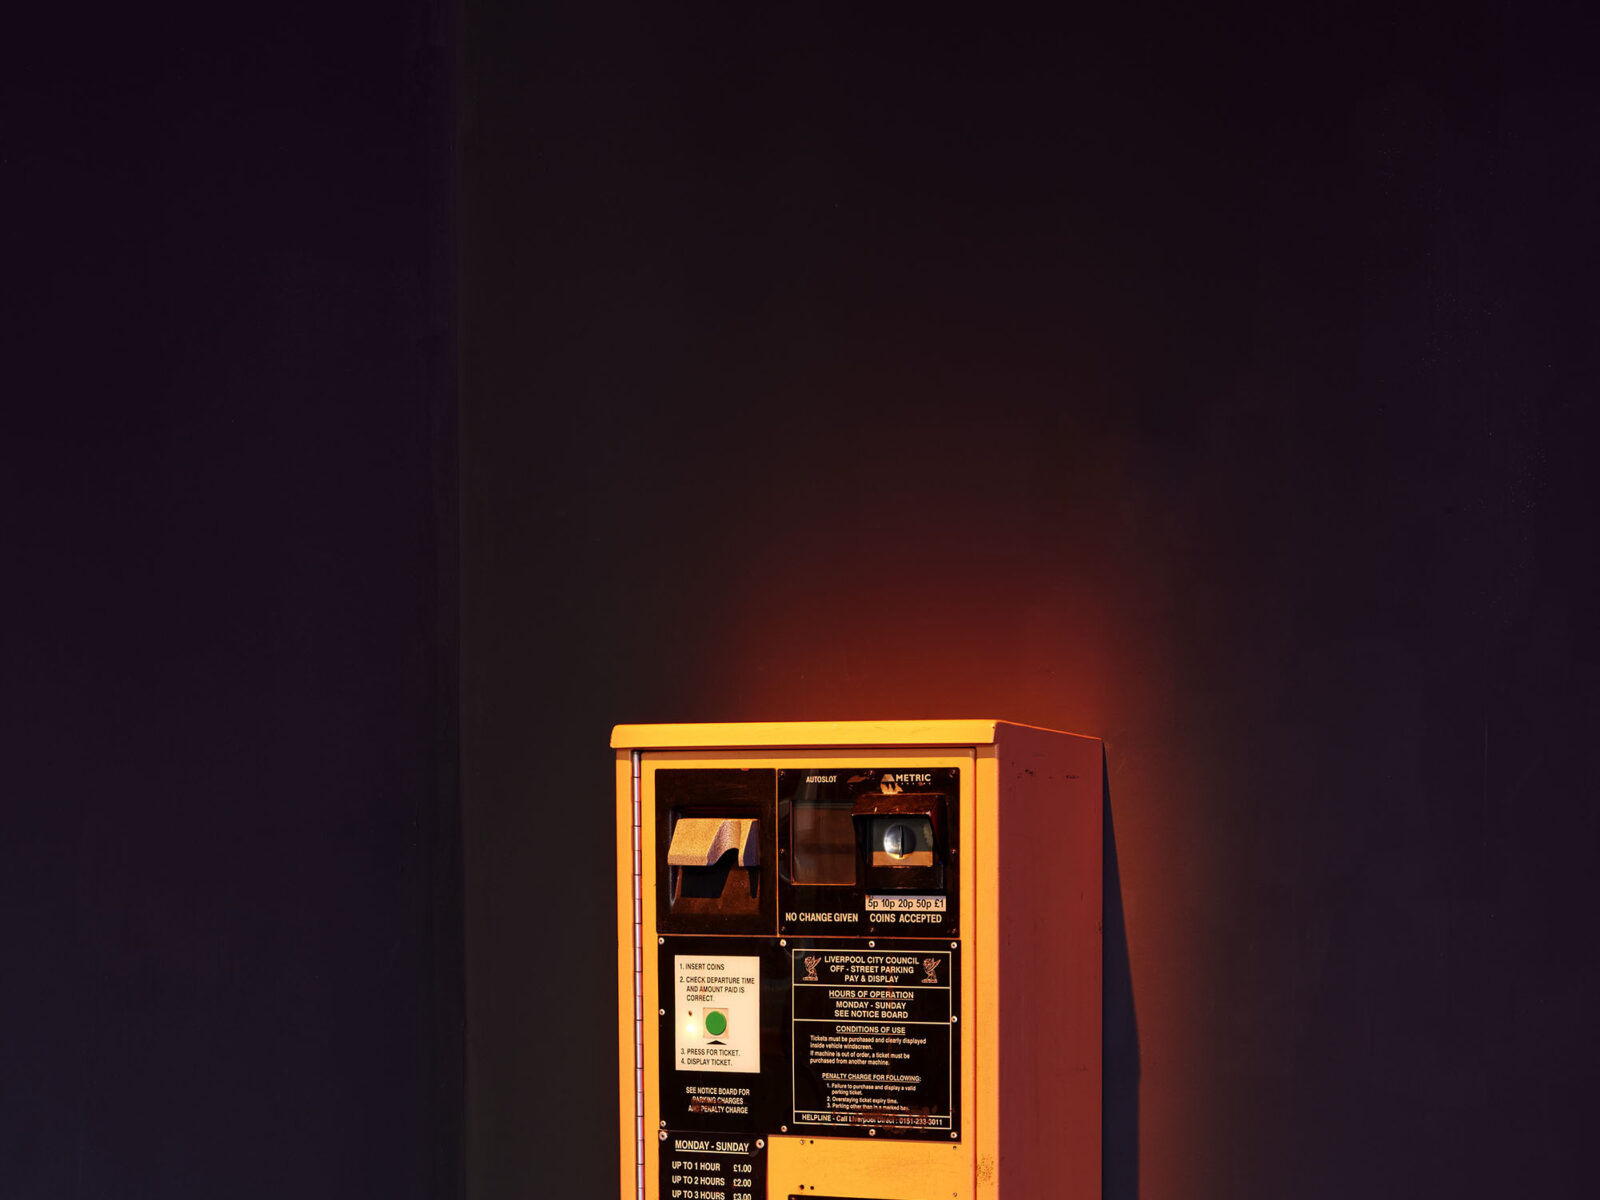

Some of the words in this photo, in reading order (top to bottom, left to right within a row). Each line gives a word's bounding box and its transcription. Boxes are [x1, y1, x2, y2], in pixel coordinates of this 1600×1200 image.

[868, 899, 878, 909] 5p
[881, 899, 895, 909] 10p
[898, 899, 913, 909] 20p
[916, 899, 931, 909] 50p
[935, 899, 944, 908] £1
[786, 912, 798, 921] NO
[799, 912, 832, 922] CHANGE
[834, 913, 858, 922] GIVEN
[870, 914, 895, 922] COINS
[899, 914, 942, 923] ACCEPTED
[825, 956, 865, 964] LIVERPOOL
[867, 956, 884, 964] CITY
[886, 957, 919, 965] COUNCIL
[829, 990, 855, 998] HOURS
[870, 991, 914, 999] OPERATION
[836, 1001, 869, 1009] MONDAY
[875, 1002, 906, 1010] SUNDAY
[881, 1011, 908, 1019] BOARD
[849, 1036, 874, 1044] purchased
[886, 1074, 921, 1082] FOLLOWING:
[726, 1106, 748, 1114] CHARGE
[802, 1114, 831, 1122] HELPLINE
[675, 1140, 709, 1150] MONDAY
[716, 1142, 749, 1151] SUNDAY
[672, 1161, 681, 1169] UP
[683, 1162, 693, 1170] TO
[700, 1162, 720, 1171] HOUR
[733, 1164, 752, 1172] £1.00
[672, 1176, 681, 1184] UP
[683, 1176, 693, 1184] TO
[700, 1177, 725, 1186] HOURS
[733, 1179, 751, 1187] £2.00
[672, 1190, 681, 1198] UP
[683, 1191, 693, 1199] TO
[694, 1191, 699, 1199] 3
[700, 1192, 725, 1200] HOURS
